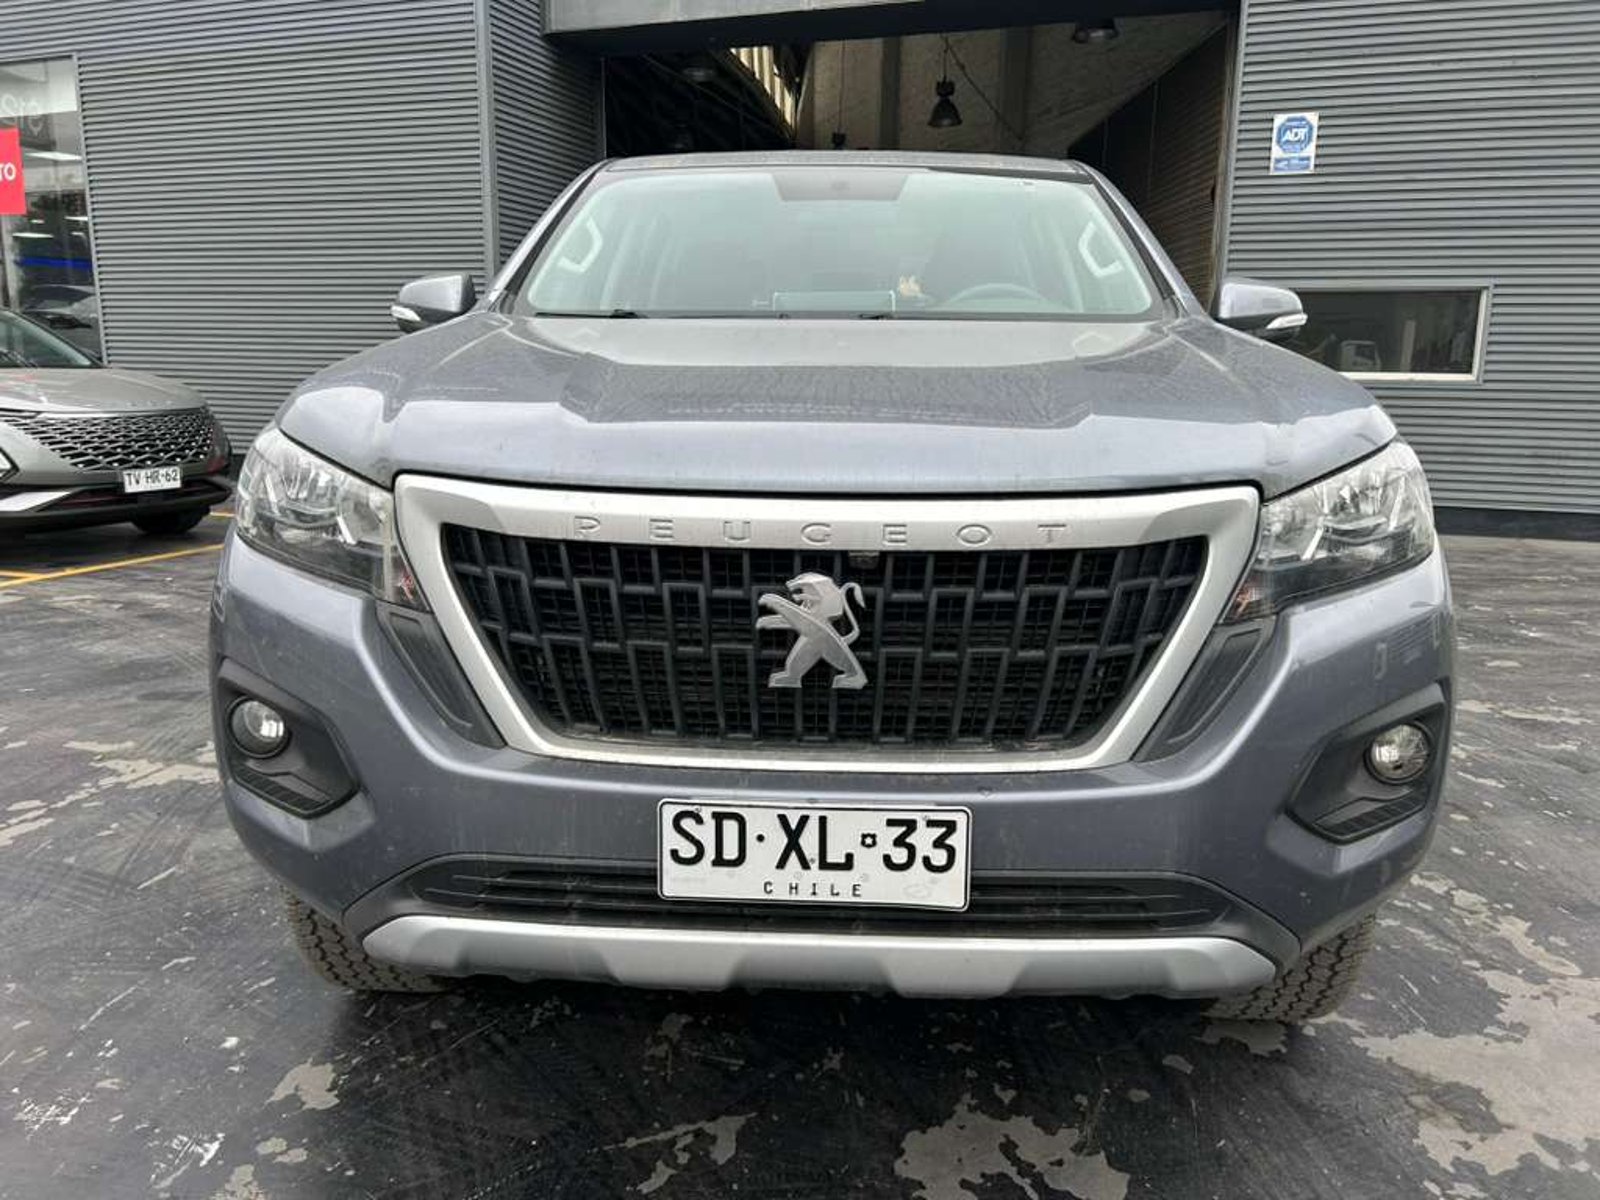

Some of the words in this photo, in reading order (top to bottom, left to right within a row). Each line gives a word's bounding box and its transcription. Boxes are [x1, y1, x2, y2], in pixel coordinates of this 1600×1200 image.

[1281, 127, 1309, 143] ADT
[573, 515, 1067, 547] PEUGEOT
[763, 881, 862, 898] CHILE
